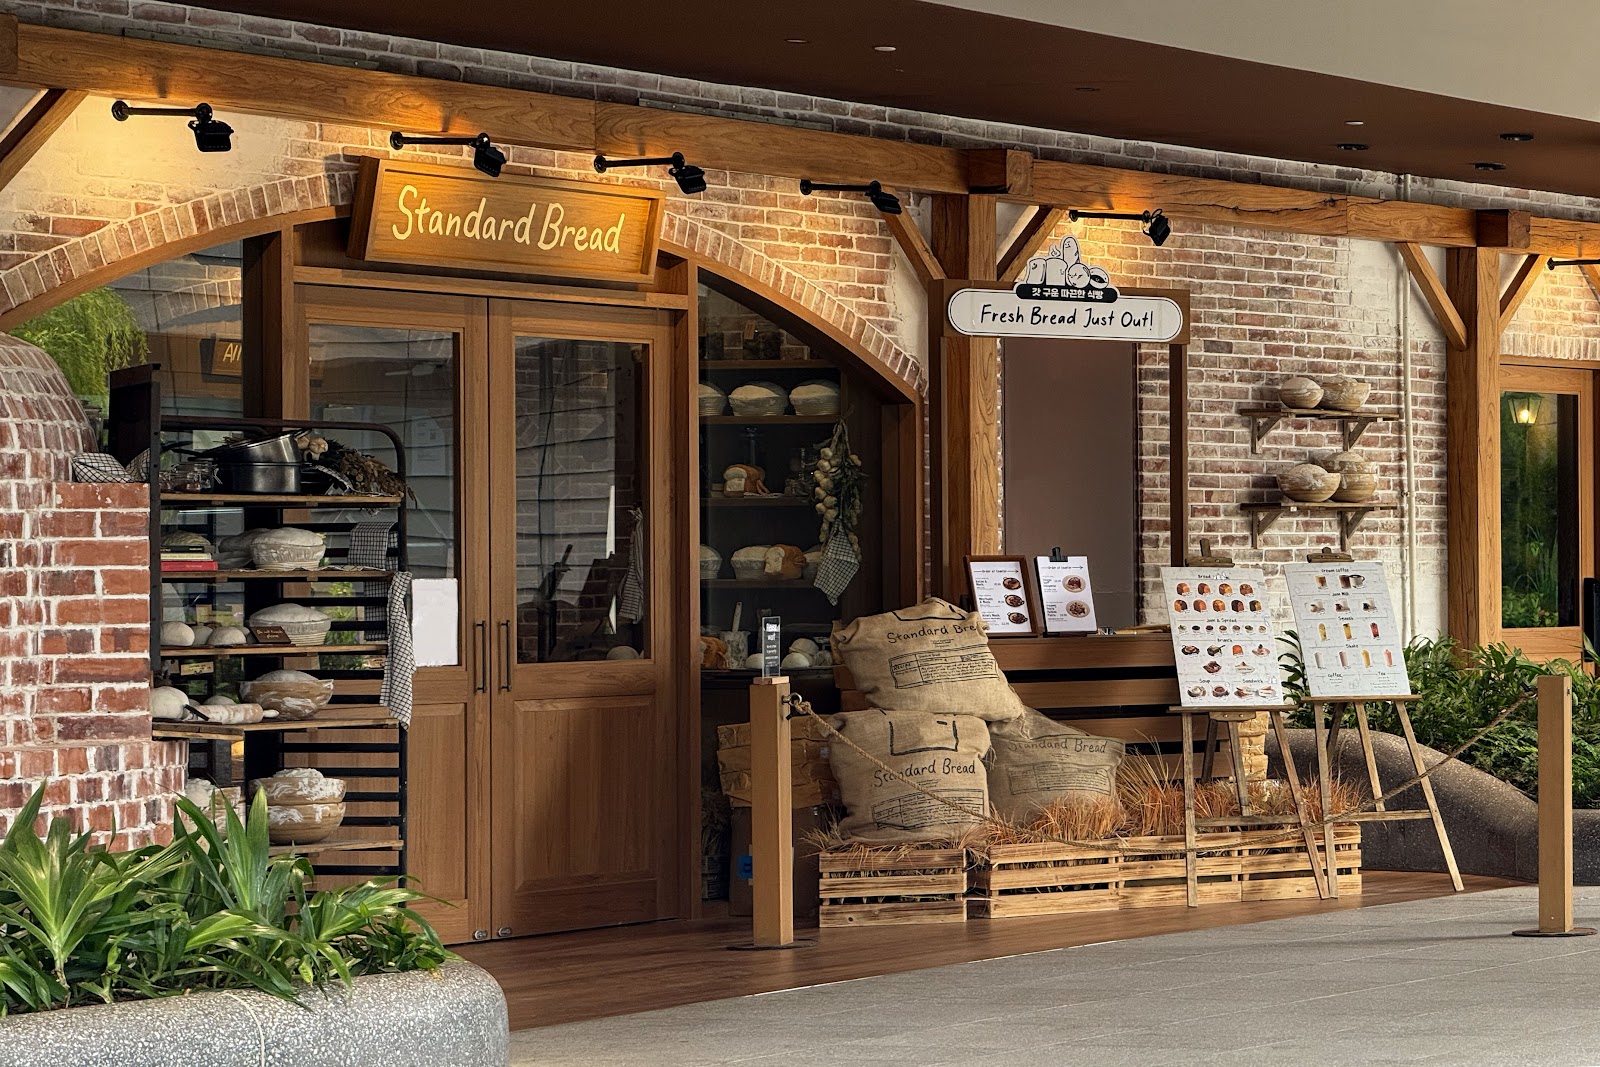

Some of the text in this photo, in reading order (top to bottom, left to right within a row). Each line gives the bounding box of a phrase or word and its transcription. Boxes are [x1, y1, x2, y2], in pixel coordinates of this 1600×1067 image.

[392, 185, 625, 254] Standard Bread
[1032, 287, 1104, 300] 갓 구운 따끈한 식빵
[980, 304, 1154, 331] Fresh Bread Just Out!
[887, 625, 949, 644] Standard
[953, 624, 977, 634] Bre
[1074, 738, 1108, 753] Bread
[942, 757, 976, 774] Bread
